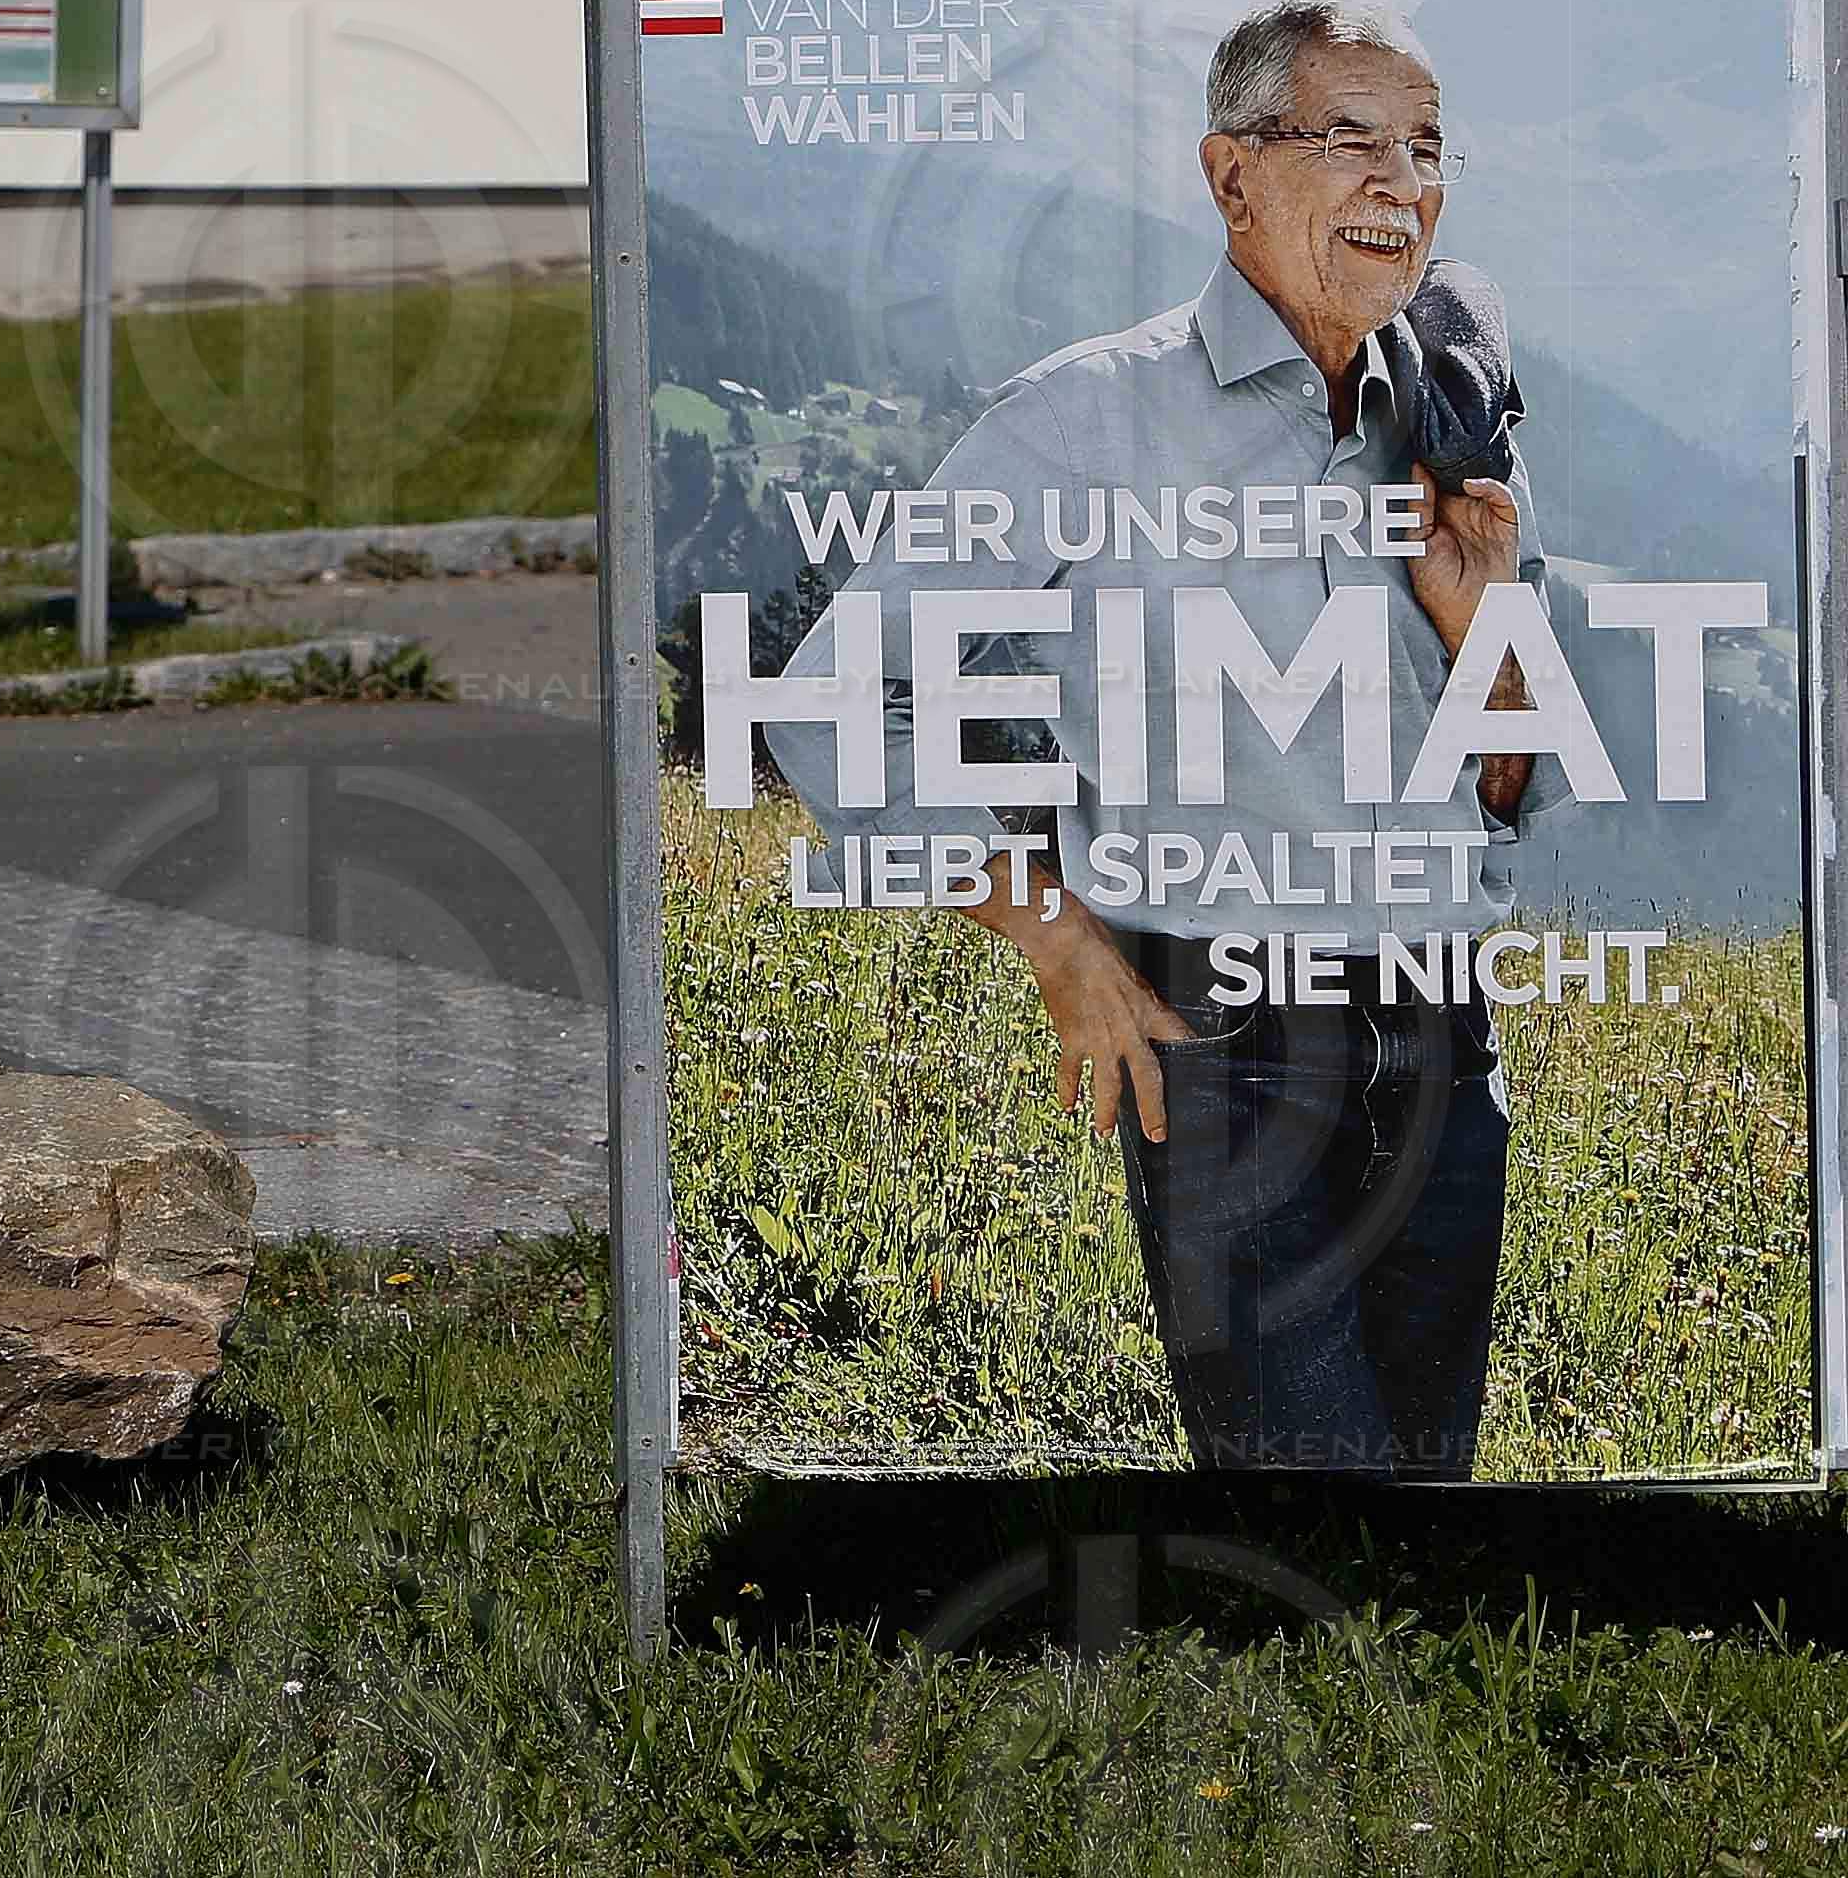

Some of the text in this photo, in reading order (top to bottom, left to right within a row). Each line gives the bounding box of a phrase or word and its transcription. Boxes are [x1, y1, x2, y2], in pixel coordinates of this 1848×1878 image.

[745, 33, 993, 86] BELLEN
[742, 88, 1025, 145] WÄHLEN
[786, 483, 1427, 565] WER UNSERE
[700, 580, 1769, 810] HEIMAT
[790, 830, 1489, 922] LIEBT, SPALTET
[1207, 930, 1681, 1008] SIE NICHT.
